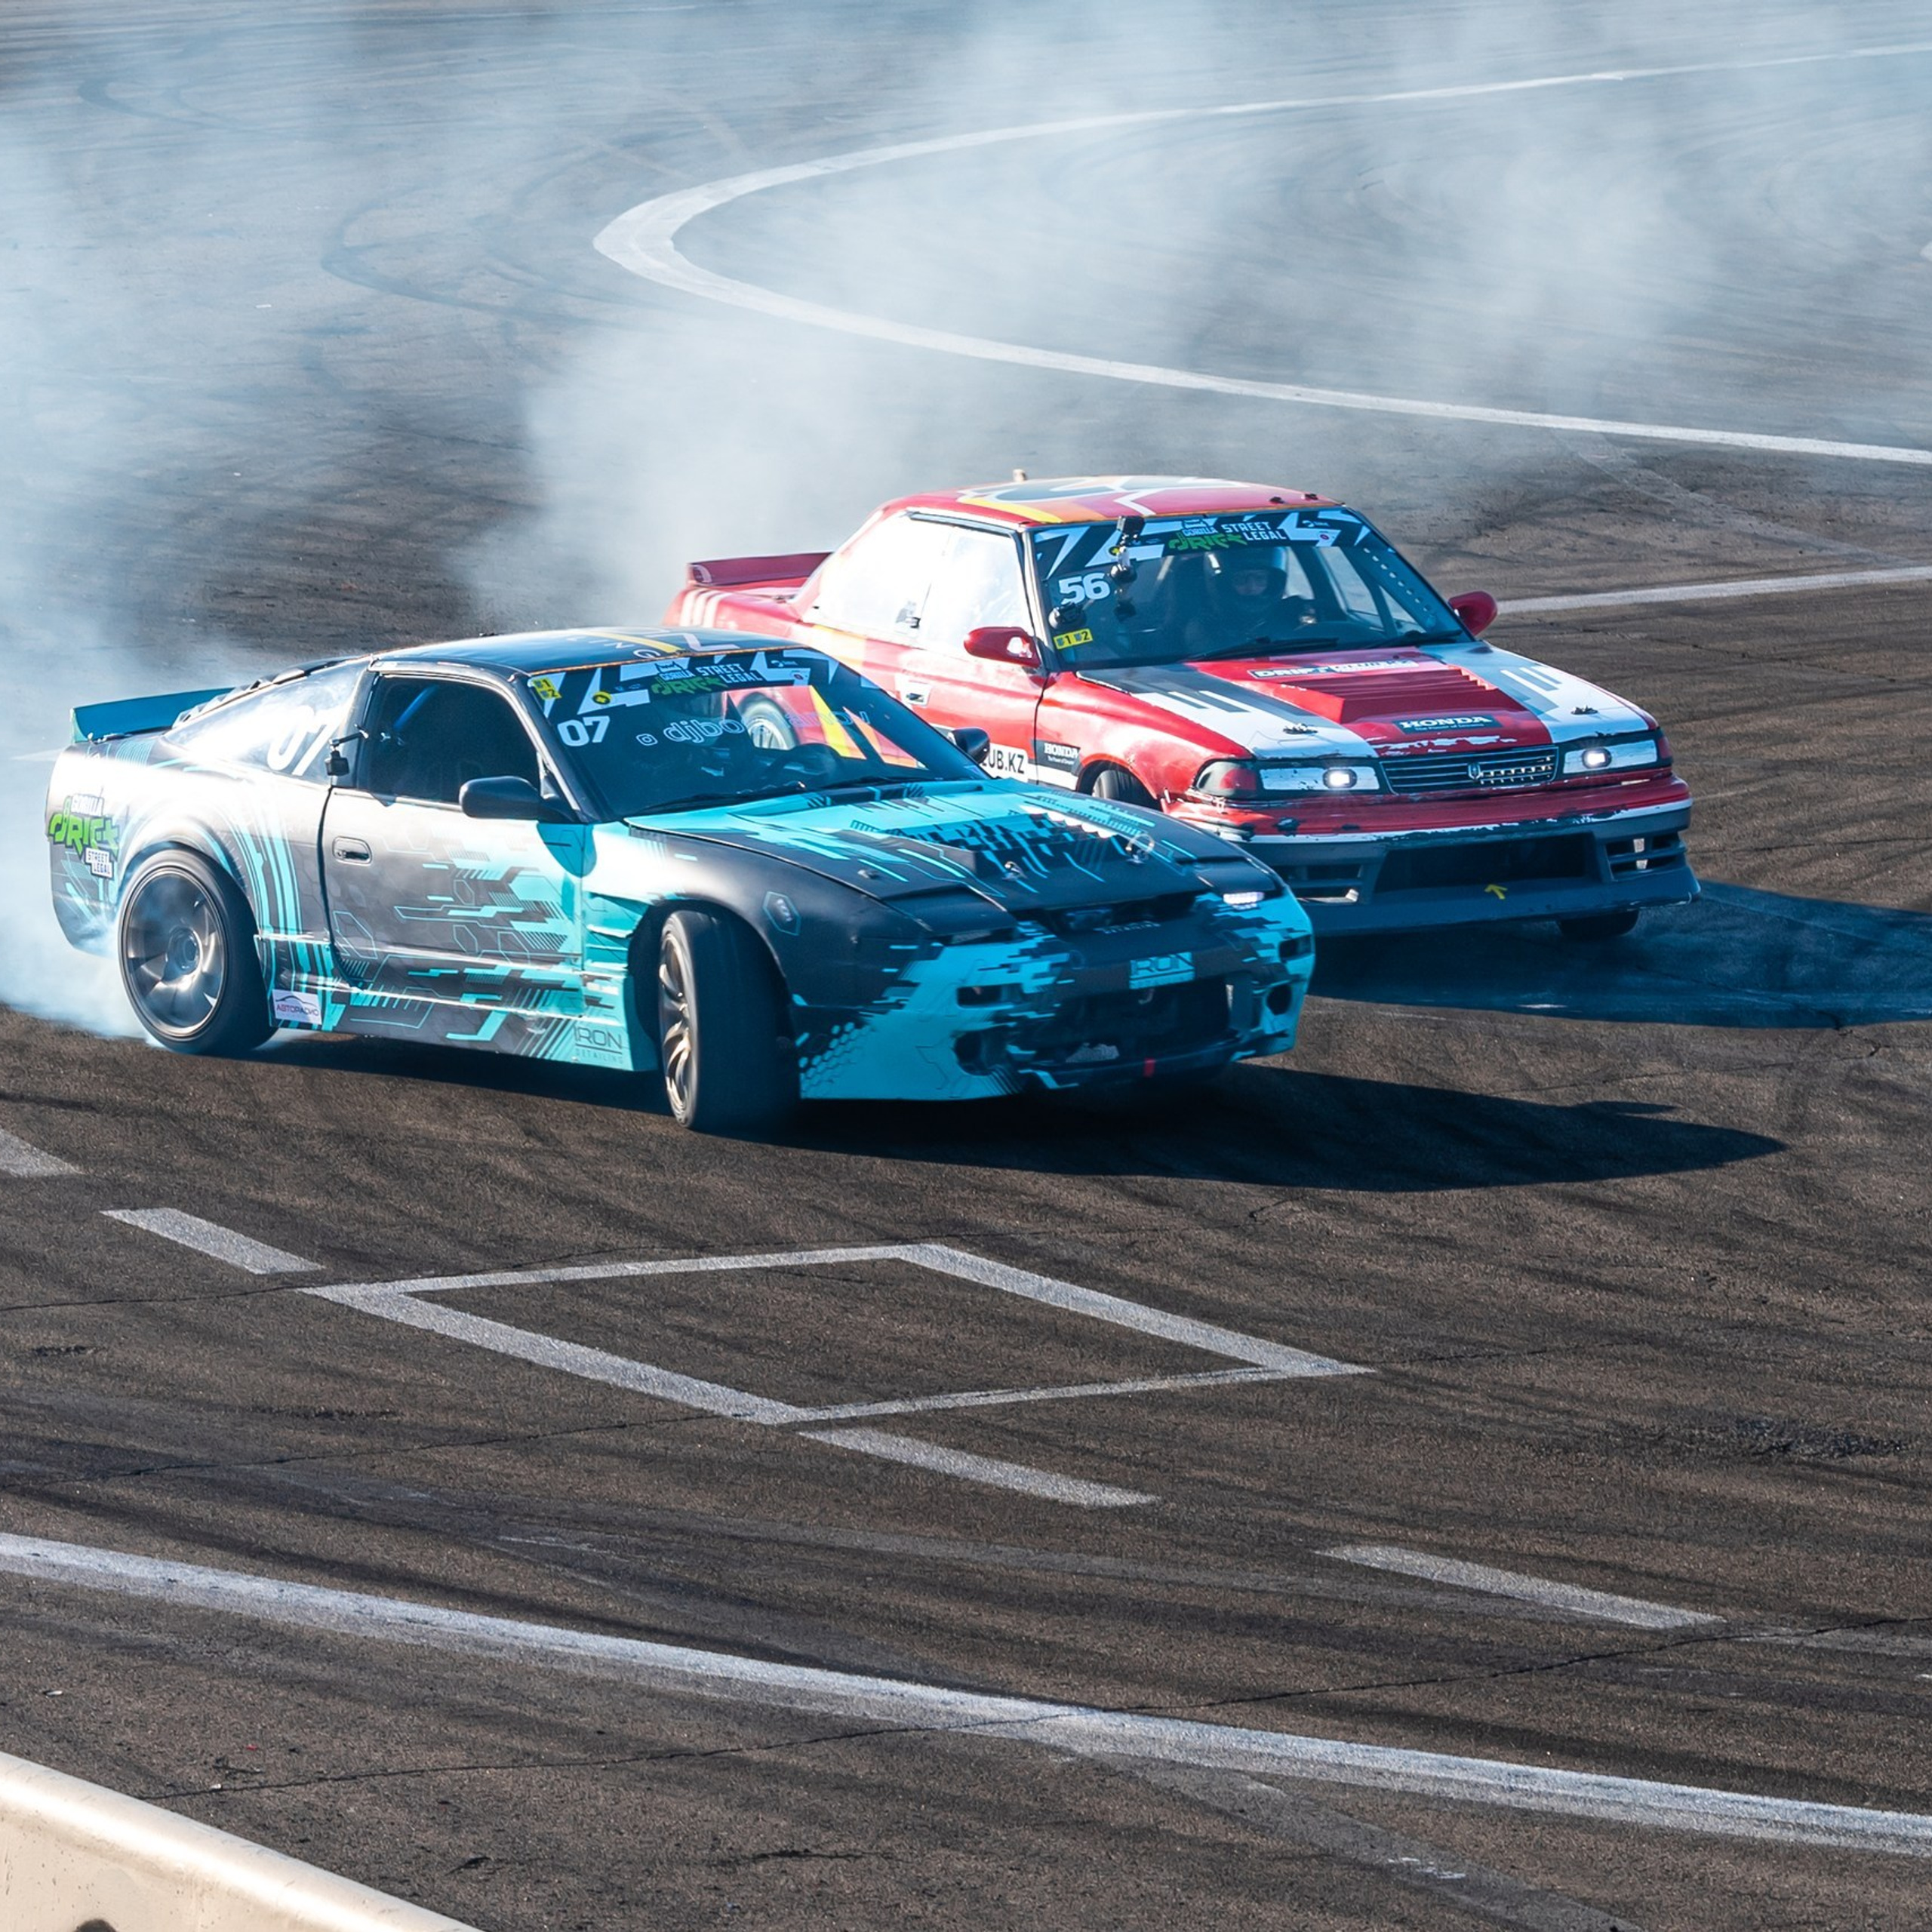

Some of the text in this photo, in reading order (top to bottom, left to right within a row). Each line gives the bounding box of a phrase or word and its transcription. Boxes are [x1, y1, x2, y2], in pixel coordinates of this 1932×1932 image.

[1220, 521, 1271, 533] STREET
[1243, 530, 1287, 541] LEGAL
[1058, 572, 1111, 605] 56
[695, 663, 745, 676] STREET
[719, 672, 763, 684] LEGAL
[1399, 716, 1493, 728] HONDA
[557, 715, 611, 747] 07
[1044, 742, 1078, 758] HONDA
[573, 1024, 623, 1049] IRON
